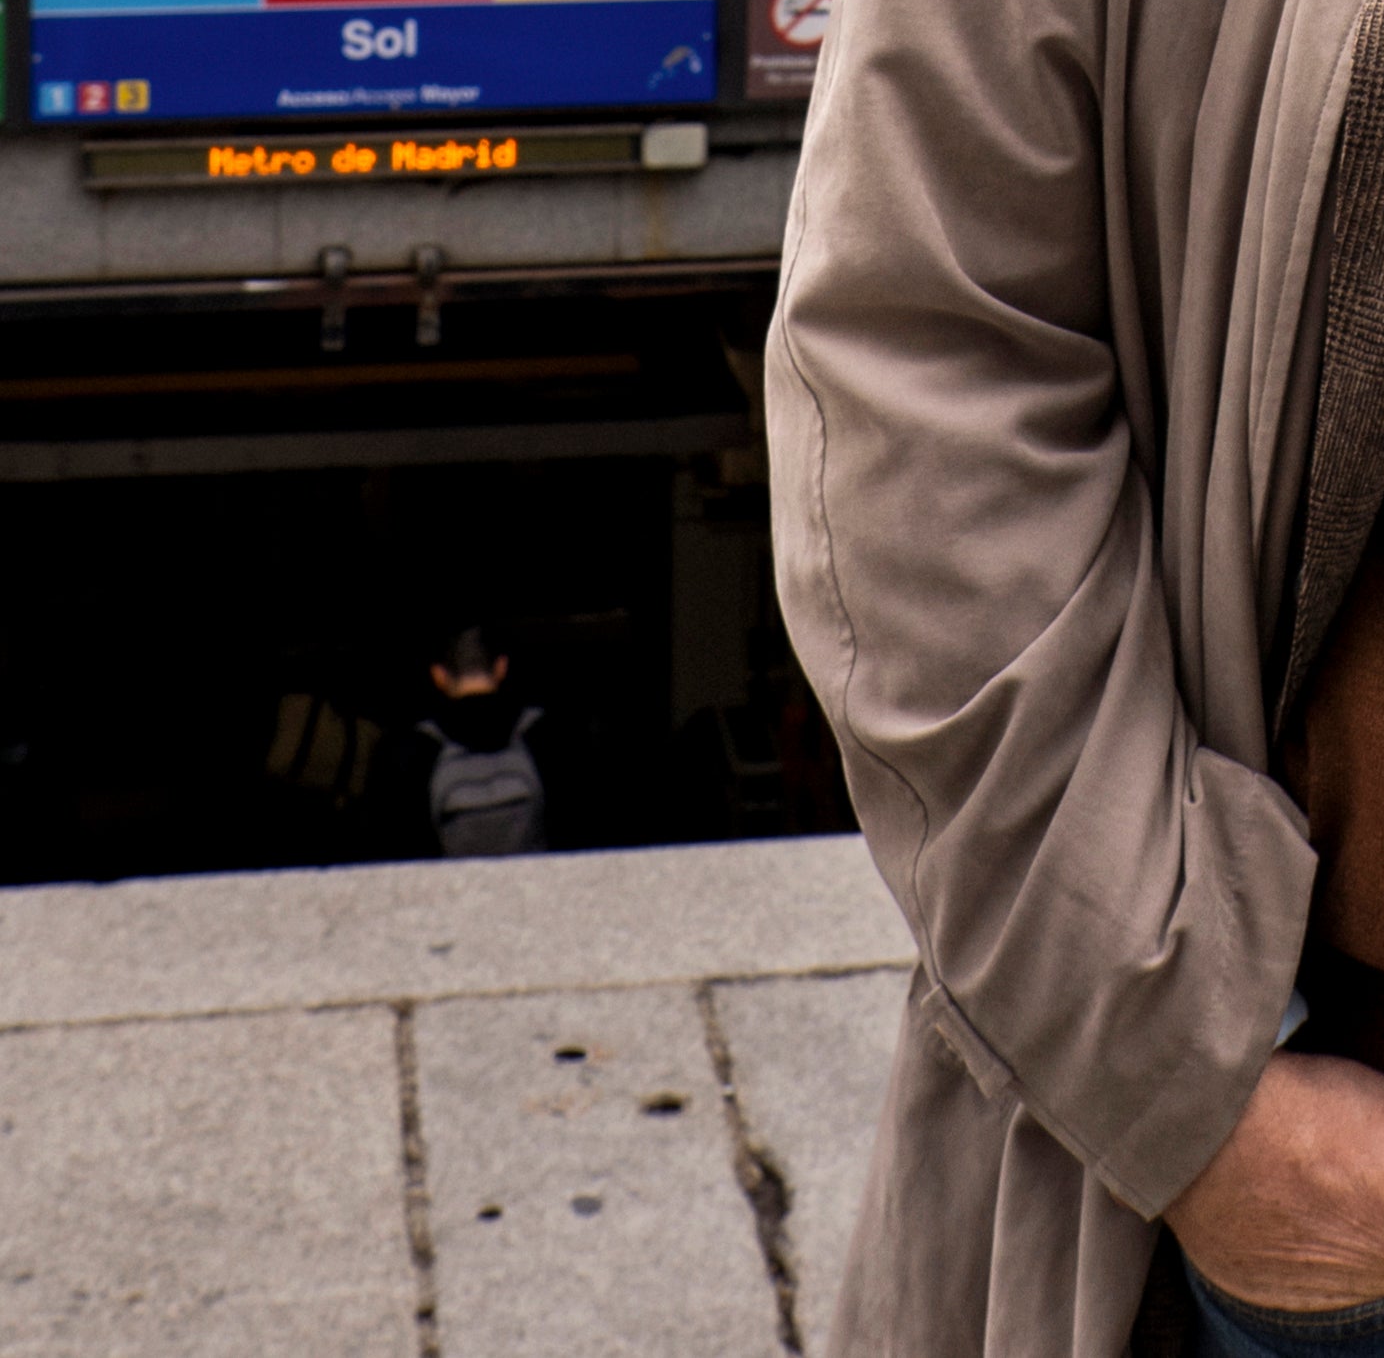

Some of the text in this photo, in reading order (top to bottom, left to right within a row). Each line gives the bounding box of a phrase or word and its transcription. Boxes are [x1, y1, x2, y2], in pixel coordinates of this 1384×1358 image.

[341, 17, 418, 61] Sol
[86, 84, 104, 110] 2
[209, 137, 518, 177] Metro de Madrid
